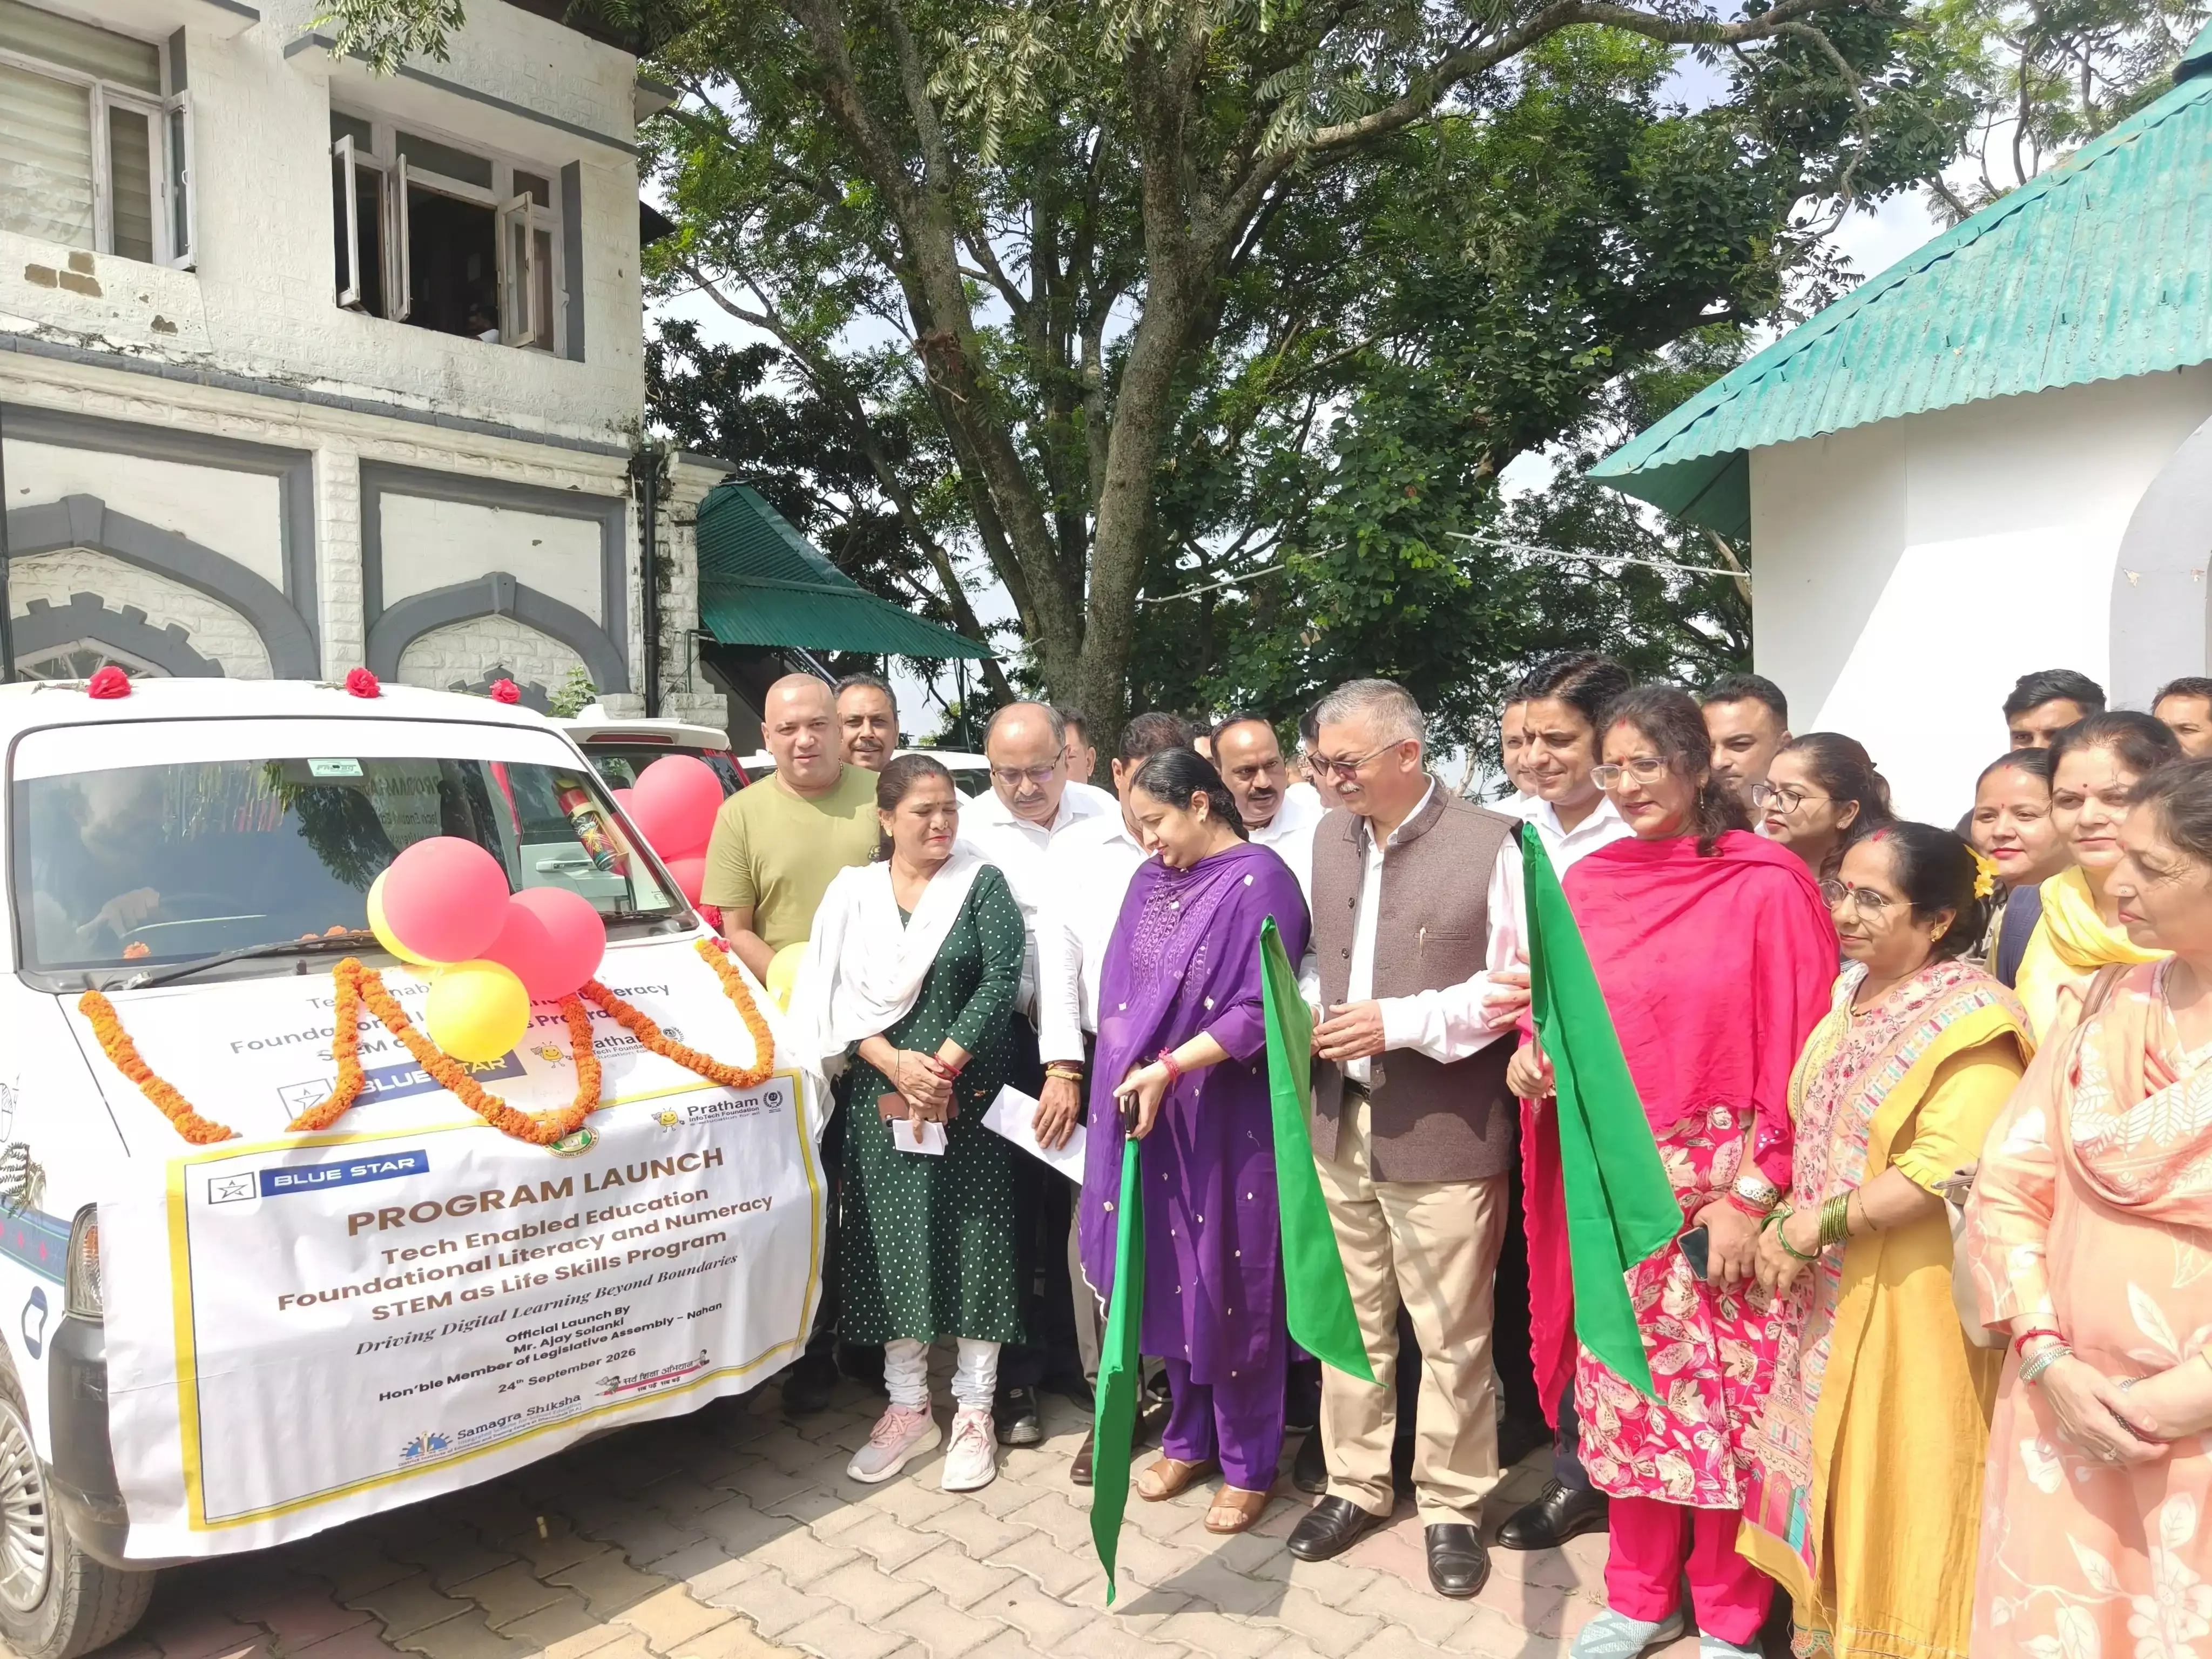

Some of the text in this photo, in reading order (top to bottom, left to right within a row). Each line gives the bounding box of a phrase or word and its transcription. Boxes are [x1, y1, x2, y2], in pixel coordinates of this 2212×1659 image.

[458, 1056, 509, 1075] TAR
[613, 1044, 644, 1053] Founda
[687, 1098, 759, 1116] Pratham
[689, 1113, 720, 1122] InfoTech
[721, 1107, 760, 1117] Foundation
[274, 1157, 415, 1187] BLUE STAR
[348, 1148, 724, 1237] PROGRAM LAUNCH
[381, 1189, 709, 1265] Tech Enabled Education
[278, 1194, 773, 1311] Foundational Literacy and Numeracy
[372, 1231, 727, 1321] STEM as Life Skills Program
[355, 1253, 739, 1355] Driving Digital Learning Beyond Boundaries
[505, 1304, 631, 1344] Official Launch By
[448, 1360, 512, 1385] Member
[515, 1354, 531, 1366] of
[533, 1334, 608, 1362] Legislative
[611, 1317, 675, 1341] Assembly
[687, 1302, 723, 1319] Nahan
[513, 1318, 625, 1354] Mr. Ajay Solanki
[498, 1347, 637, 1394] 24th September 2026
[639, 1370, 659, 1381] शिक्षा
[661, 1360, 694, 1375] अभियान
[457, 1394, 582, 1440] Samagra Shiksha
